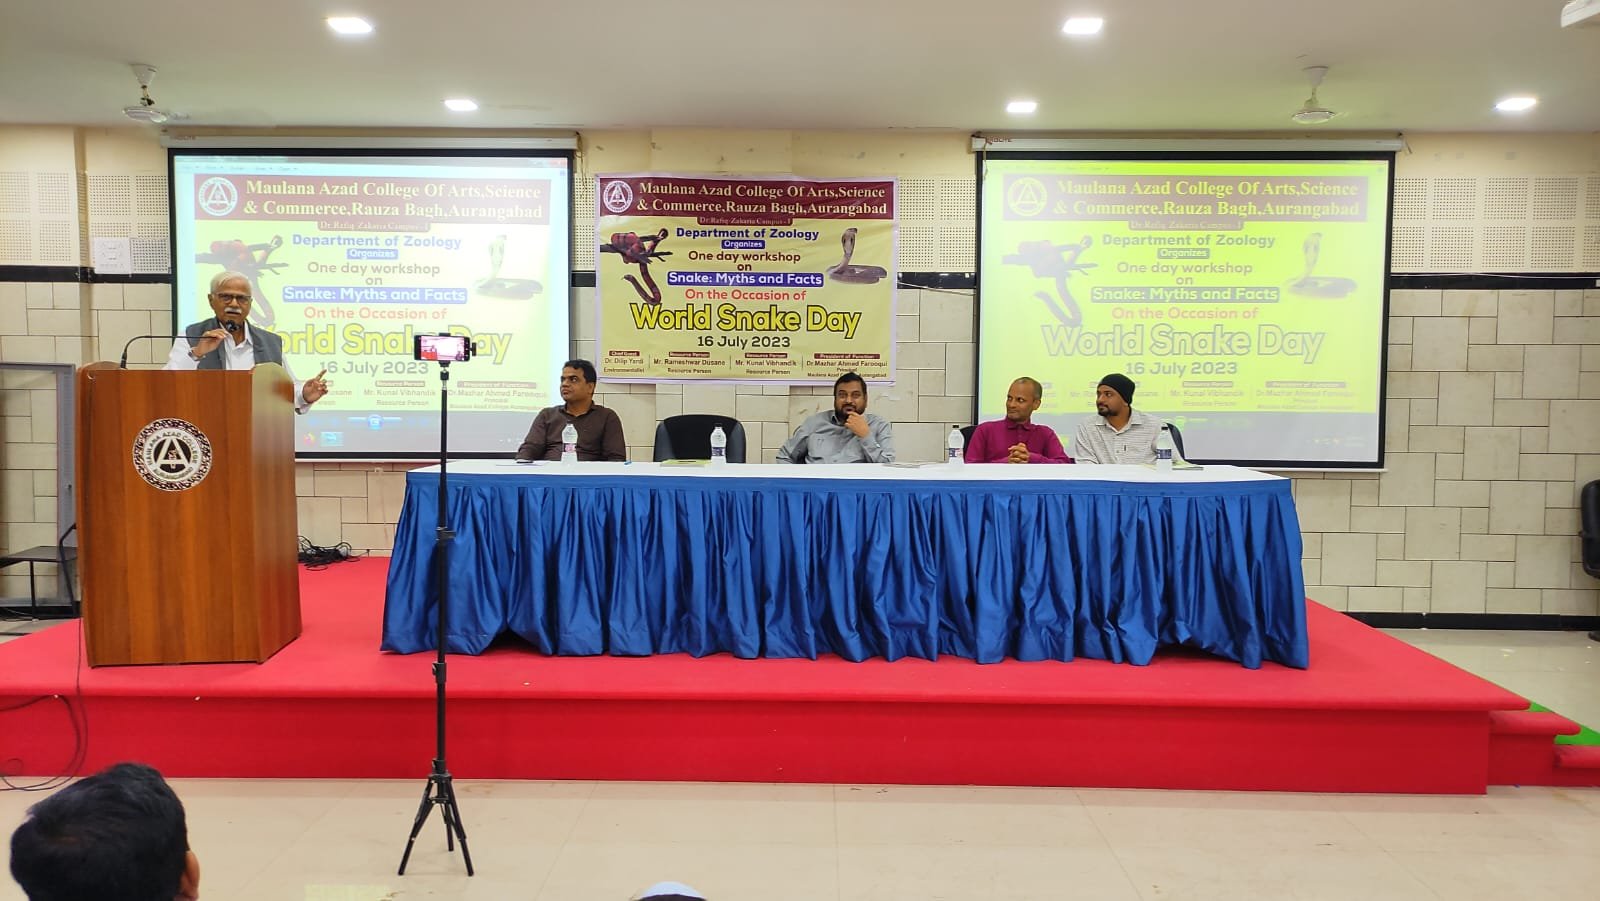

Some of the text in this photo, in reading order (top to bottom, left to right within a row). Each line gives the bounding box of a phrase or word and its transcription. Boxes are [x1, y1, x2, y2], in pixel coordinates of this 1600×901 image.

[246, 180, 541, 201] Maulana Azad College Of Arts,Science
[639, 182, 885, 199] Maulana Azad College Of Arts,Science
[1056, 180, 1358, 199] Maulana Azad College Of Arts,Science
[244, 200, 257, 215] &
[637, 199, 887, 216] & Commerce,Rauza Bagh,Aurangabad
[1054, 200, 1068, 215] &
[676, 228, 819, 241] Department of Zoology
[1103, 234, 1275, 248] Department of Zoology
[293, 234, 461, 250] Department of Zoology
[724, 240, 763, 249] Organizes
[350, 249, 395, 259] Organizes
[688, 251, 801, 263] One day workshop
[1160, 248, 1207, 258] Organizes
[307, 262, 440, 277] One day workshop
[737, 263, 752, 271] on
[1117, 262, 1253, 276] One day workshop
[365, 276, 383, 286] on
[669, 272, 822, 286] Snake: Myths and Facts
[1176, 275, 1193, 285] on
[284, 287, 465, 303] Snake: Myths and Facts
[685, 289, 807, 301] On the Occasion of
[1092, 287, 1278, 302] Snake: Myths and Facts
[304, 307, 447, 320] On the Occasion of
[1112, 307, 1259, 319] On the Occasion of
[630, 303, 862, 339] World Snake Day
[264, 323, 336, 355] orld
[697, 336, 791, 350] 16 July 2023
[1041, 323, 1325, 364] World Snake Day
[320, 361, 428, 377] 16 July 2023
[1126, 362, 1238, 378] 16 July 2023
